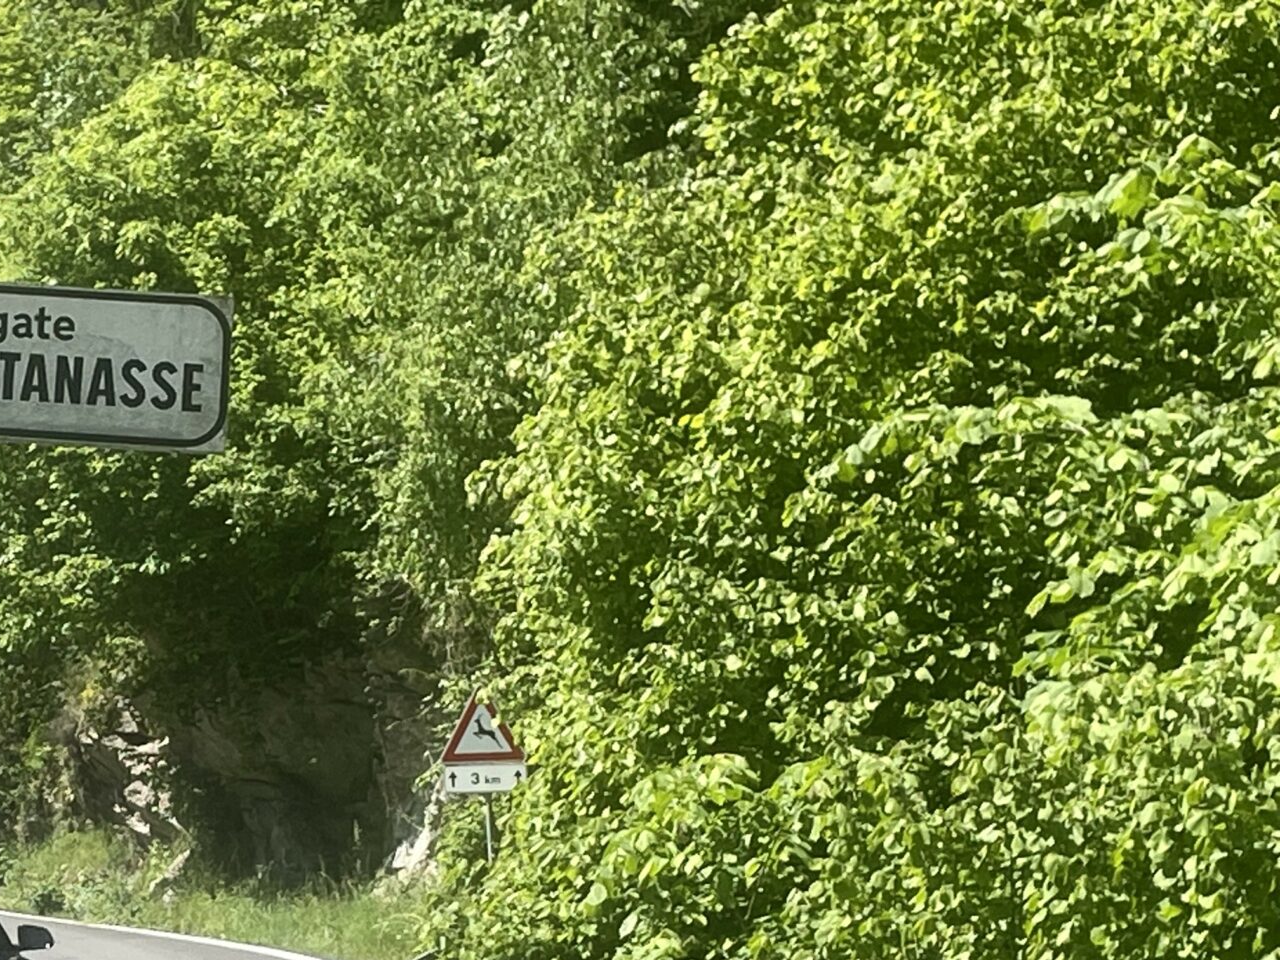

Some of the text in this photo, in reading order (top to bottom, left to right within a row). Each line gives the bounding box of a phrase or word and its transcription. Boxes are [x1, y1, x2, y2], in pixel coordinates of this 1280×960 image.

[0, 351, 204, 412] TANASSE
[471, 772, 501, 785] 3 km
